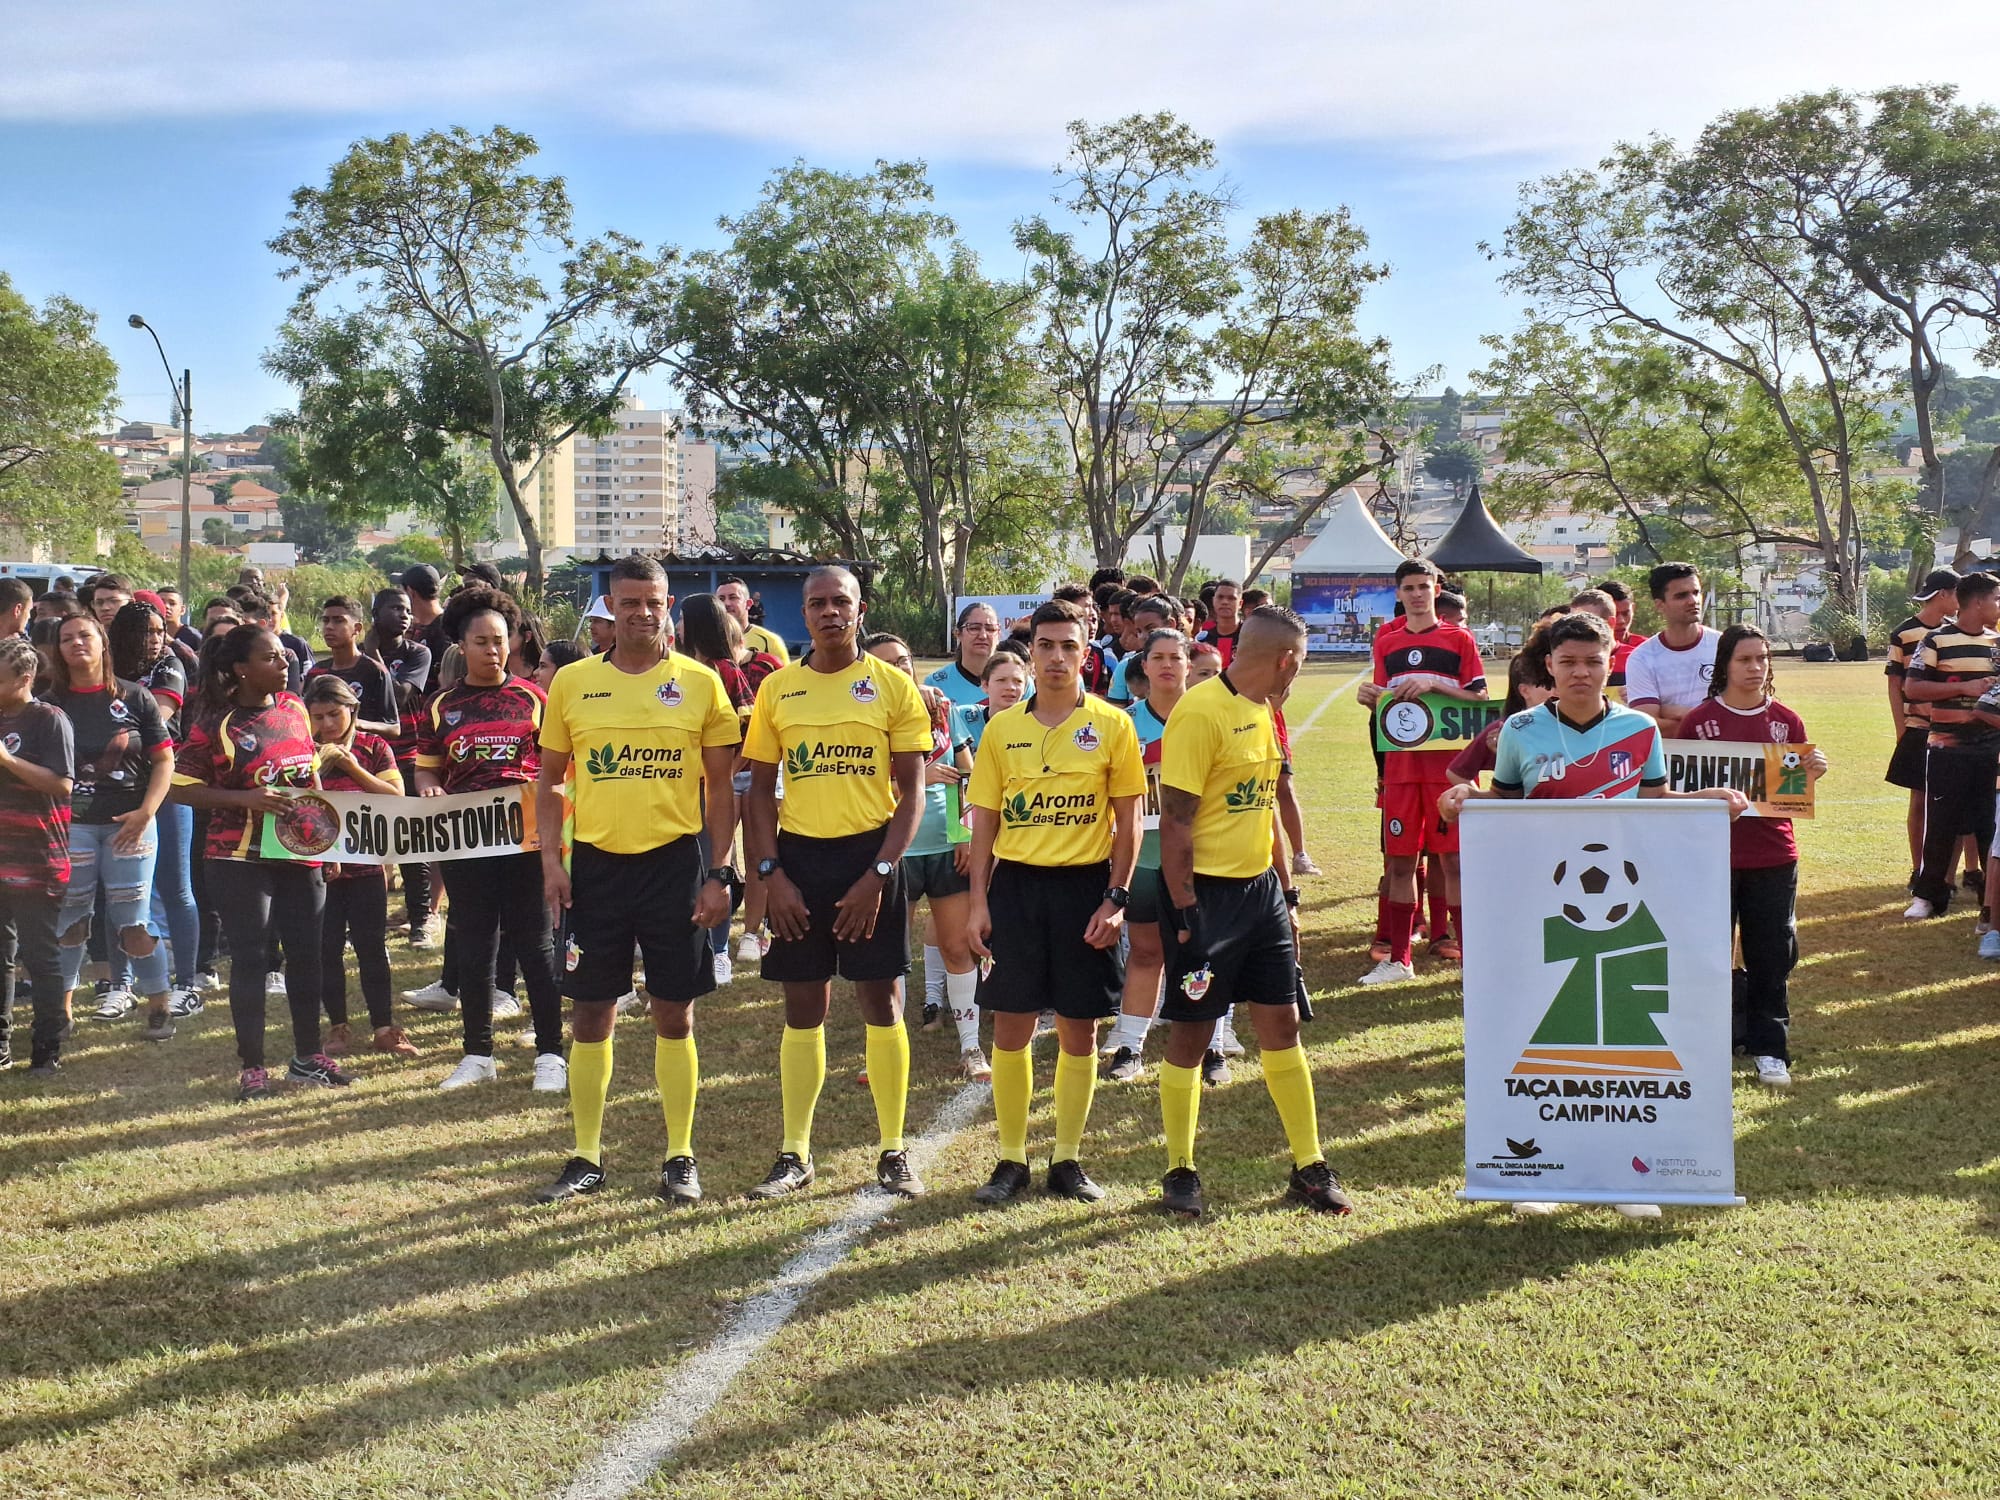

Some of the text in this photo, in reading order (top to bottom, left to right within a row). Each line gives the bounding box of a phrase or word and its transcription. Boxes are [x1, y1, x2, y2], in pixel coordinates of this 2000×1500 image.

[474, 735, 521, 744] INSTITUTO
[474, 744, 518, 761] RZ9
[617, 744, 682, 762] Aroma
[812, 741, 874, 759] Aroma
[1535, 752, 1567, 783] 20
[1664, 754, 1767, 802] PANEMA
[1030, 791, 1096, 810] Aroma
[344, 796, 525, 857] SÃO CRISTOVÃO
[952, 1008, 975, 1021] 24
[1504, 1078, 1562, 1101] TAÇA
[1606, 1080, 1692, 1100] FAVELAS
[1539, 1103, 1658, 1124] CAMPINAS
[1655, 1158, 1697, 1167] INSTITUTO
[1656, 1168, 1684, 1177] HENRY
